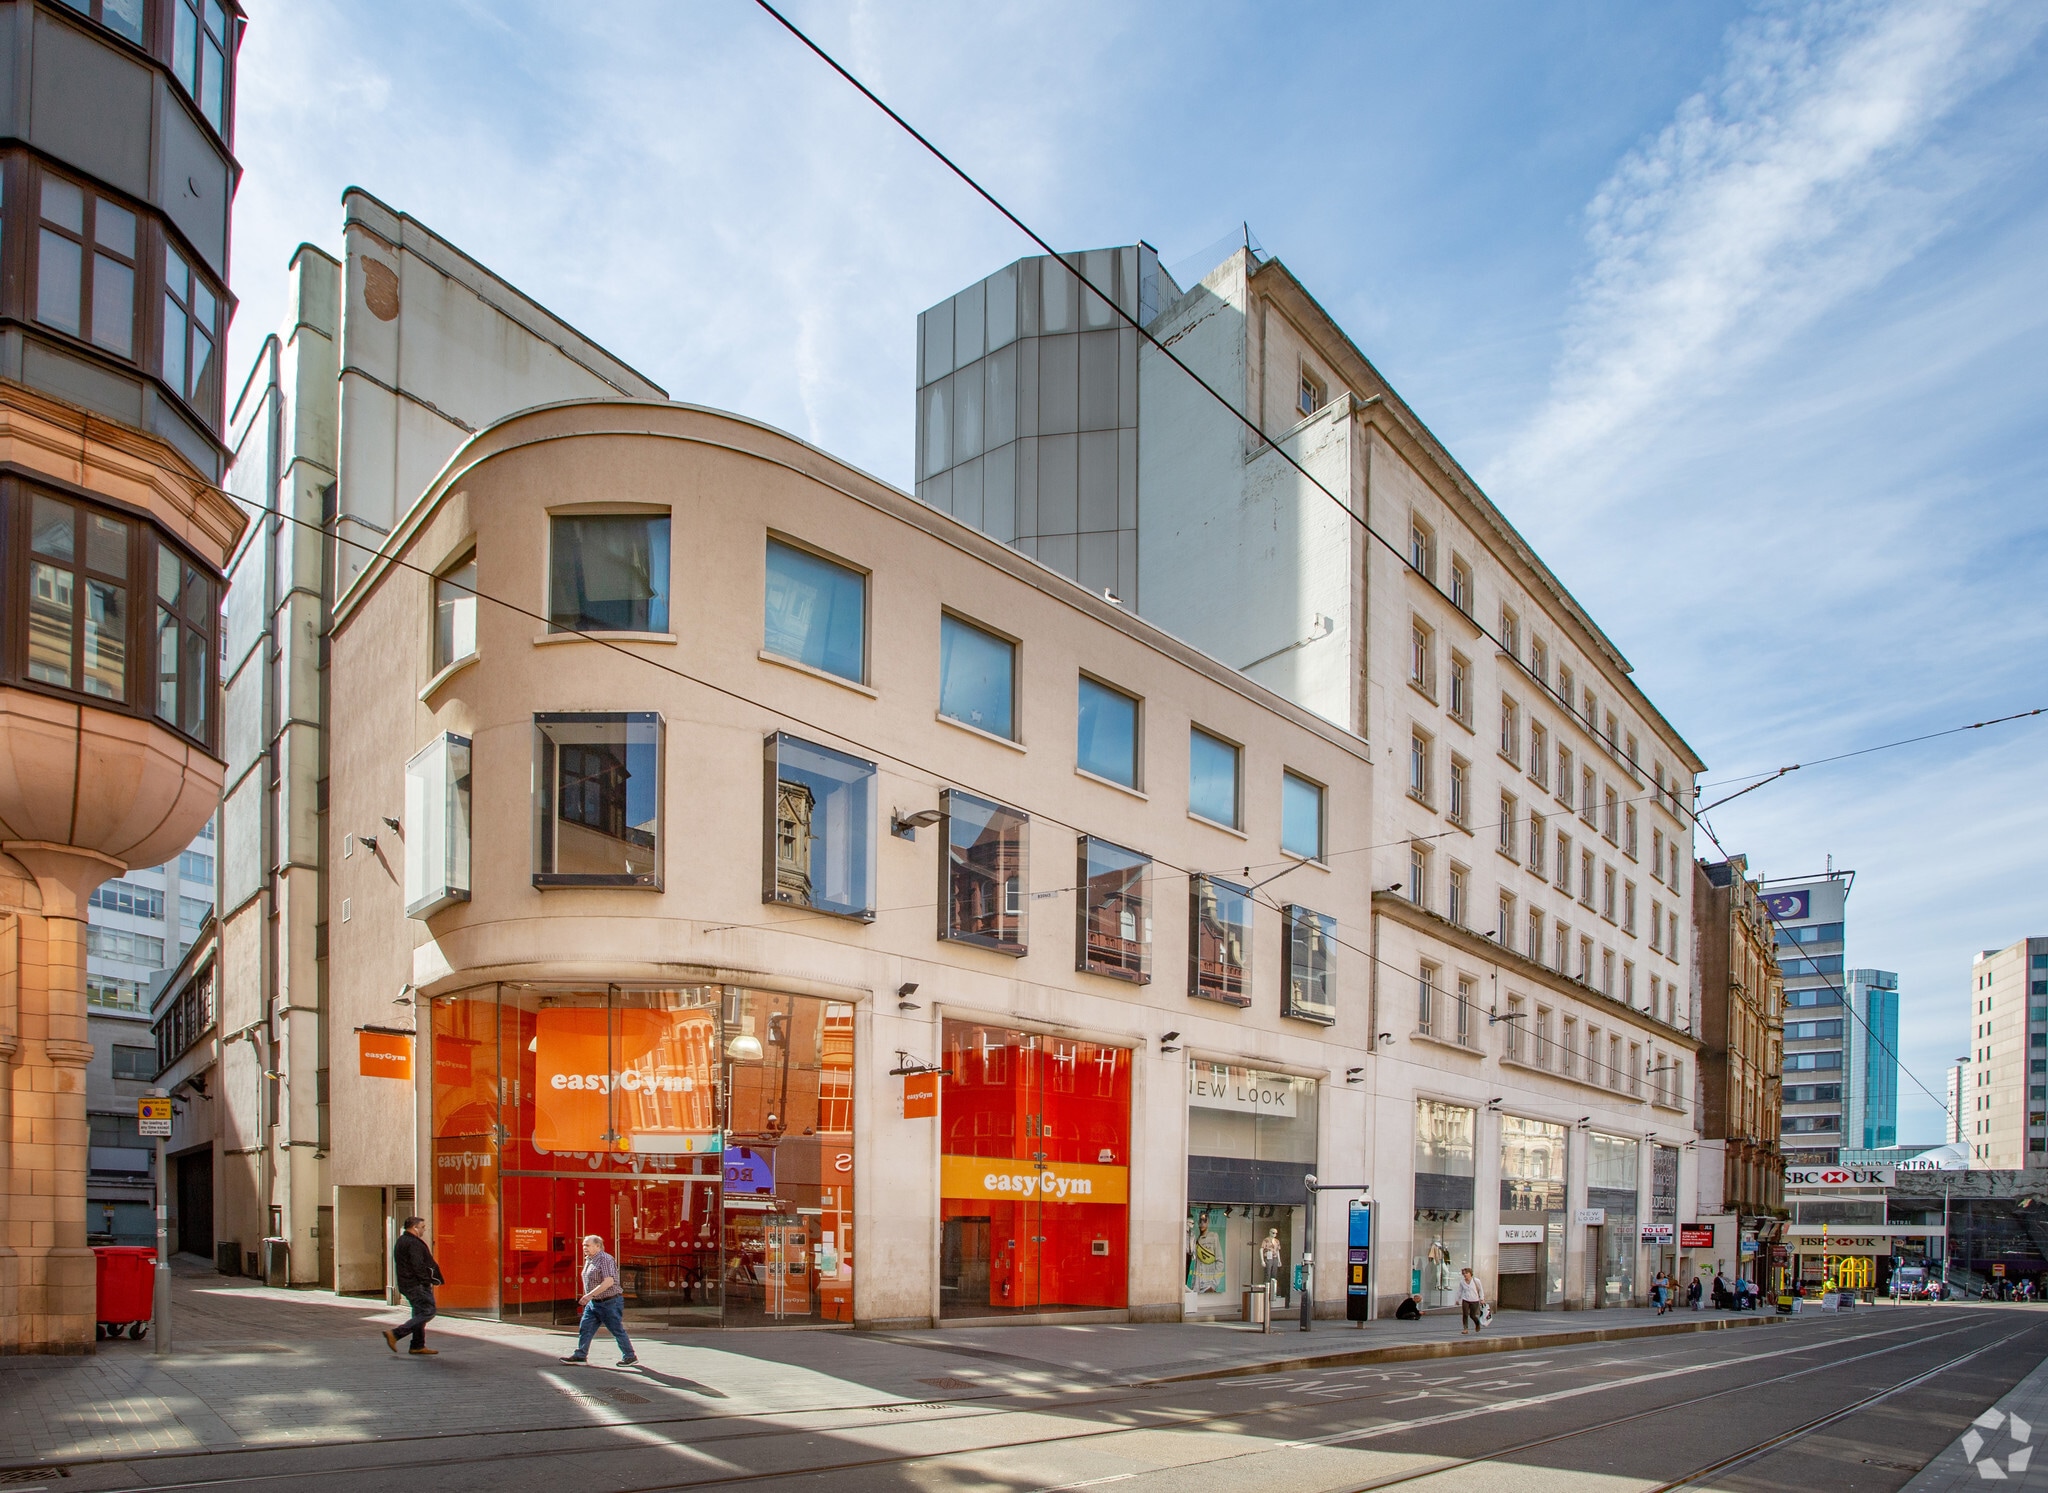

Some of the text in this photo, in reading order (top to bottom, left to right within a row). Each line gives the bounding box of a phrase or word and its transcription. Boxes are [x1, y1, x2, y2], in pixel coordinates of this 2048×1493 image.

[365, 1052, 406, 1061] easyGym
[551, 1070, 693, 1095] easyGym
[907, 1092, 933, 1100] easyGym
[1237, 1086, 1285, 1106] LOOK
[438, 1151, 492, 1170] easyGym
[1785, 1171, 1885, 1183] SBC UK
[444, 1183, 485, 1196] NO CONTRACT
[984, 1171, 1092, 1198] easyGym
[1505, 1230, 1537, 1238] NEW LOOK
[1856, 1238, 1876, 1246] UK
